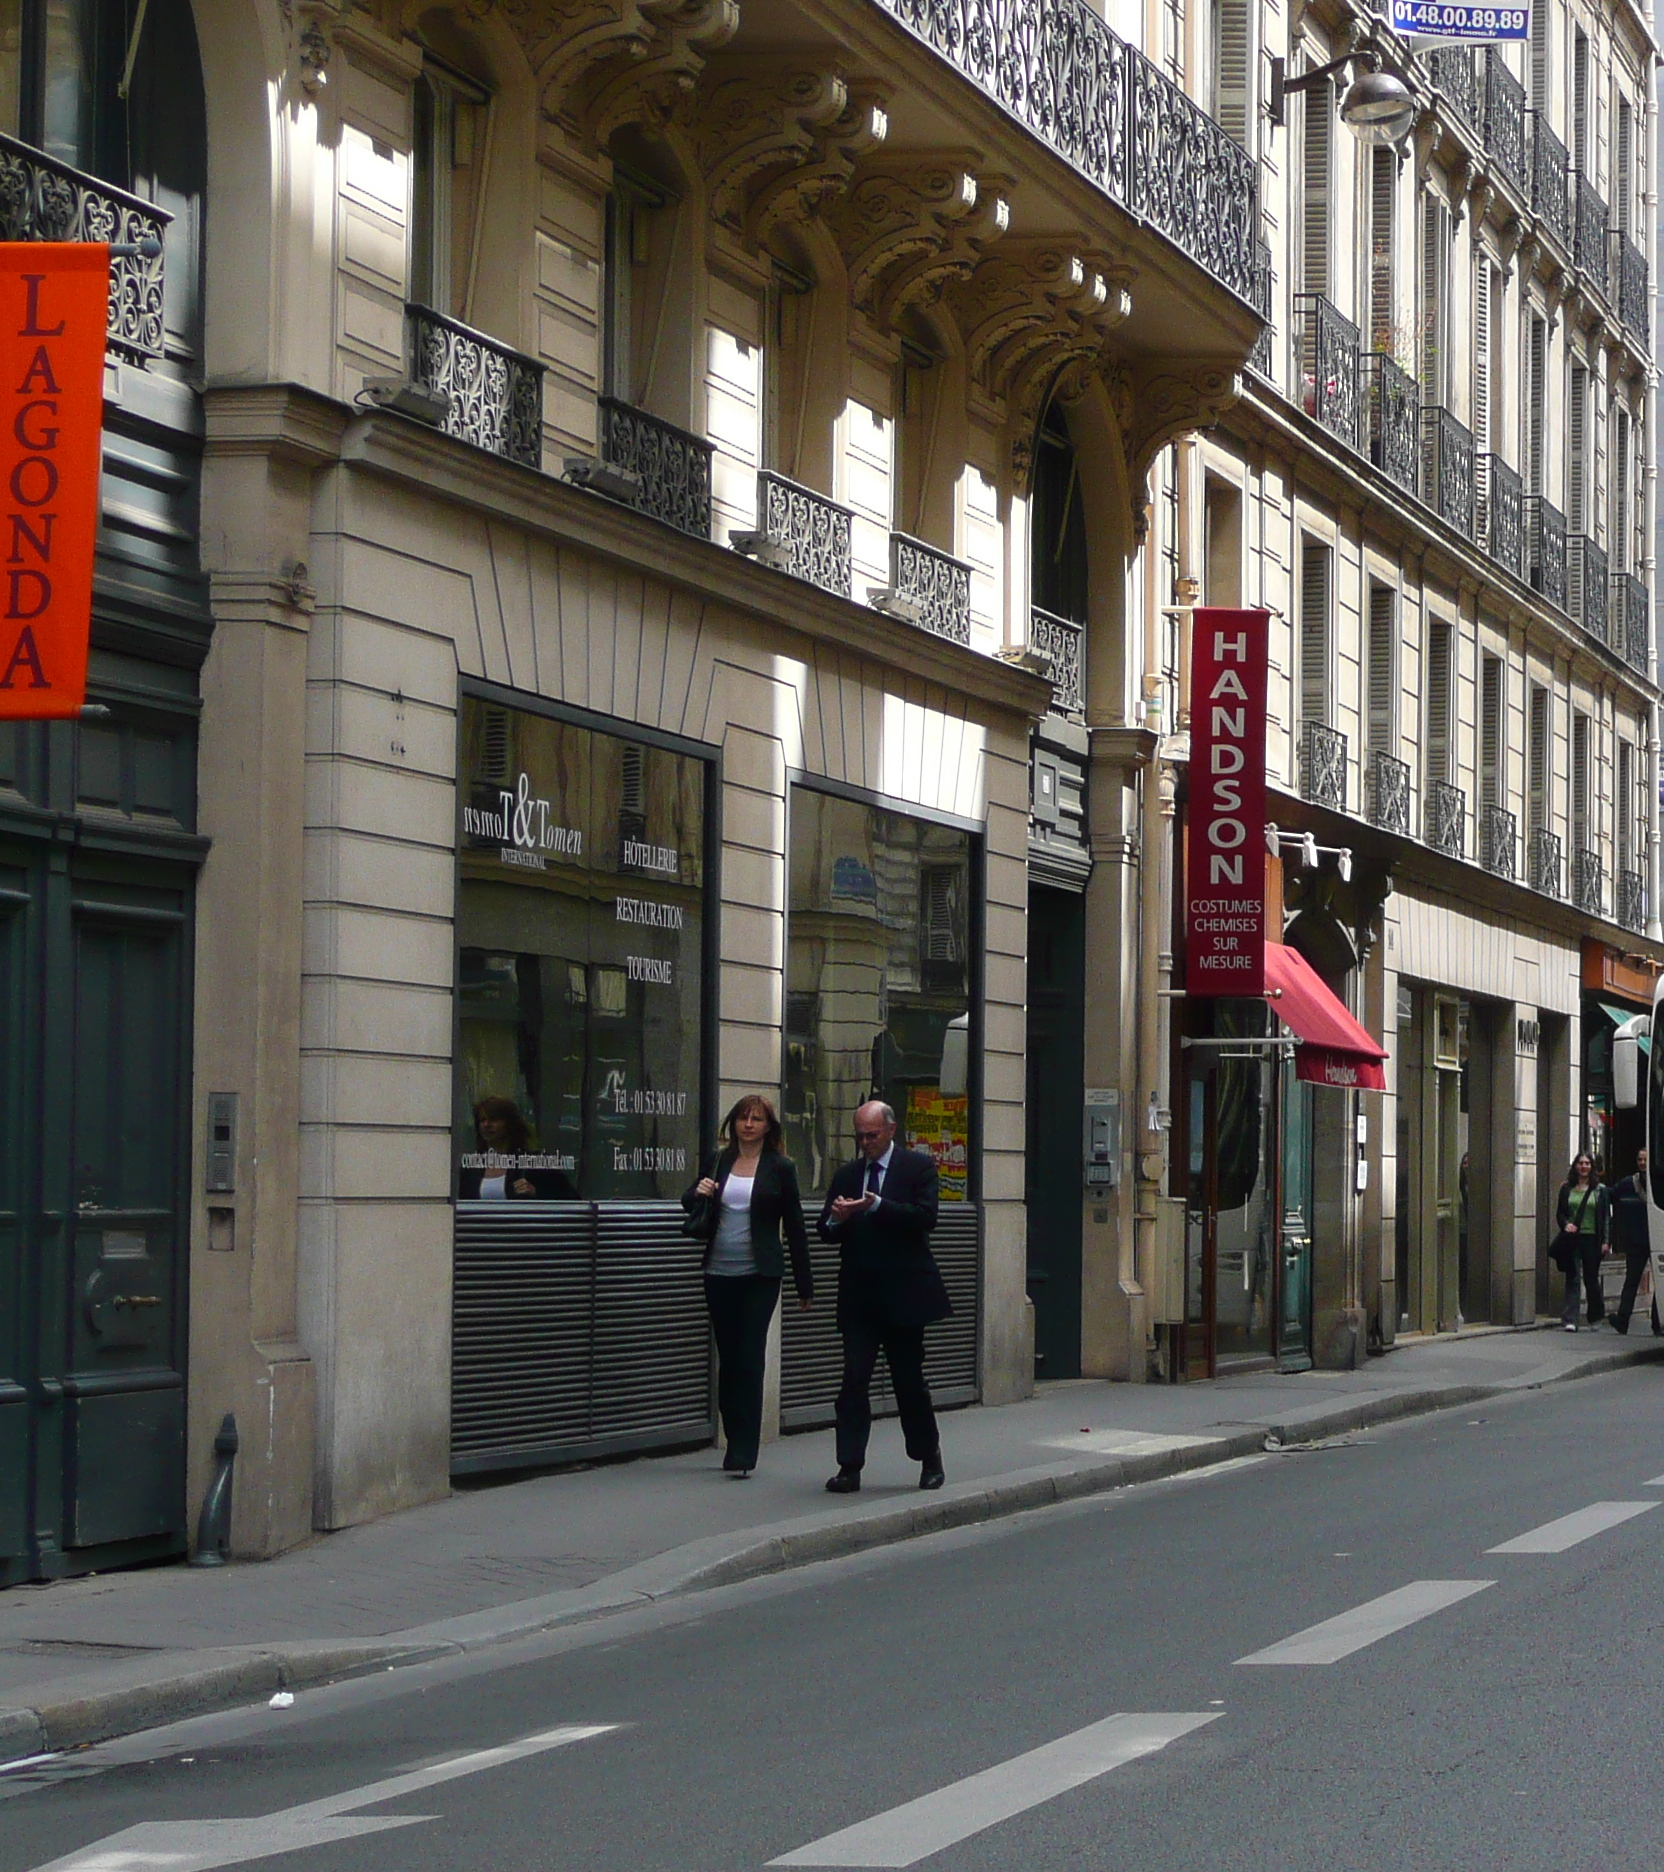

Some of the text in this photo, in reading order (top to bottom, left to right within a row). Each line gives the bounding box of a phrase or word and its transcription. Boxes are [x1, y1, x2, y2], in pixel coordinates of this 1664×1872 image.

[1394, 1, 1524, 30] 01.48.00.89.89
[0, 274, 66, 689] LAGONDA
[1207, 631, 1249, 885] HANDSON
[536, 799, 582, 855] Tomen
[501, 847, 547, 870] INTERNATIONAL
[624, 835, 677, 873] HÔTELLERIE
[616, 896, 683, 930] RESTAURATION
[1190, 900, 1262, 913] COSTUMES
[1194, 918, 1258, 932] CHEMISES
[1213, 936, 1239, 950] SUR
[627, 956, 673, 984] TOURISME
[1199, 955, 1252, 969] MESURE
[461, 1147, 575, 1169] contact@tomen-international.com
